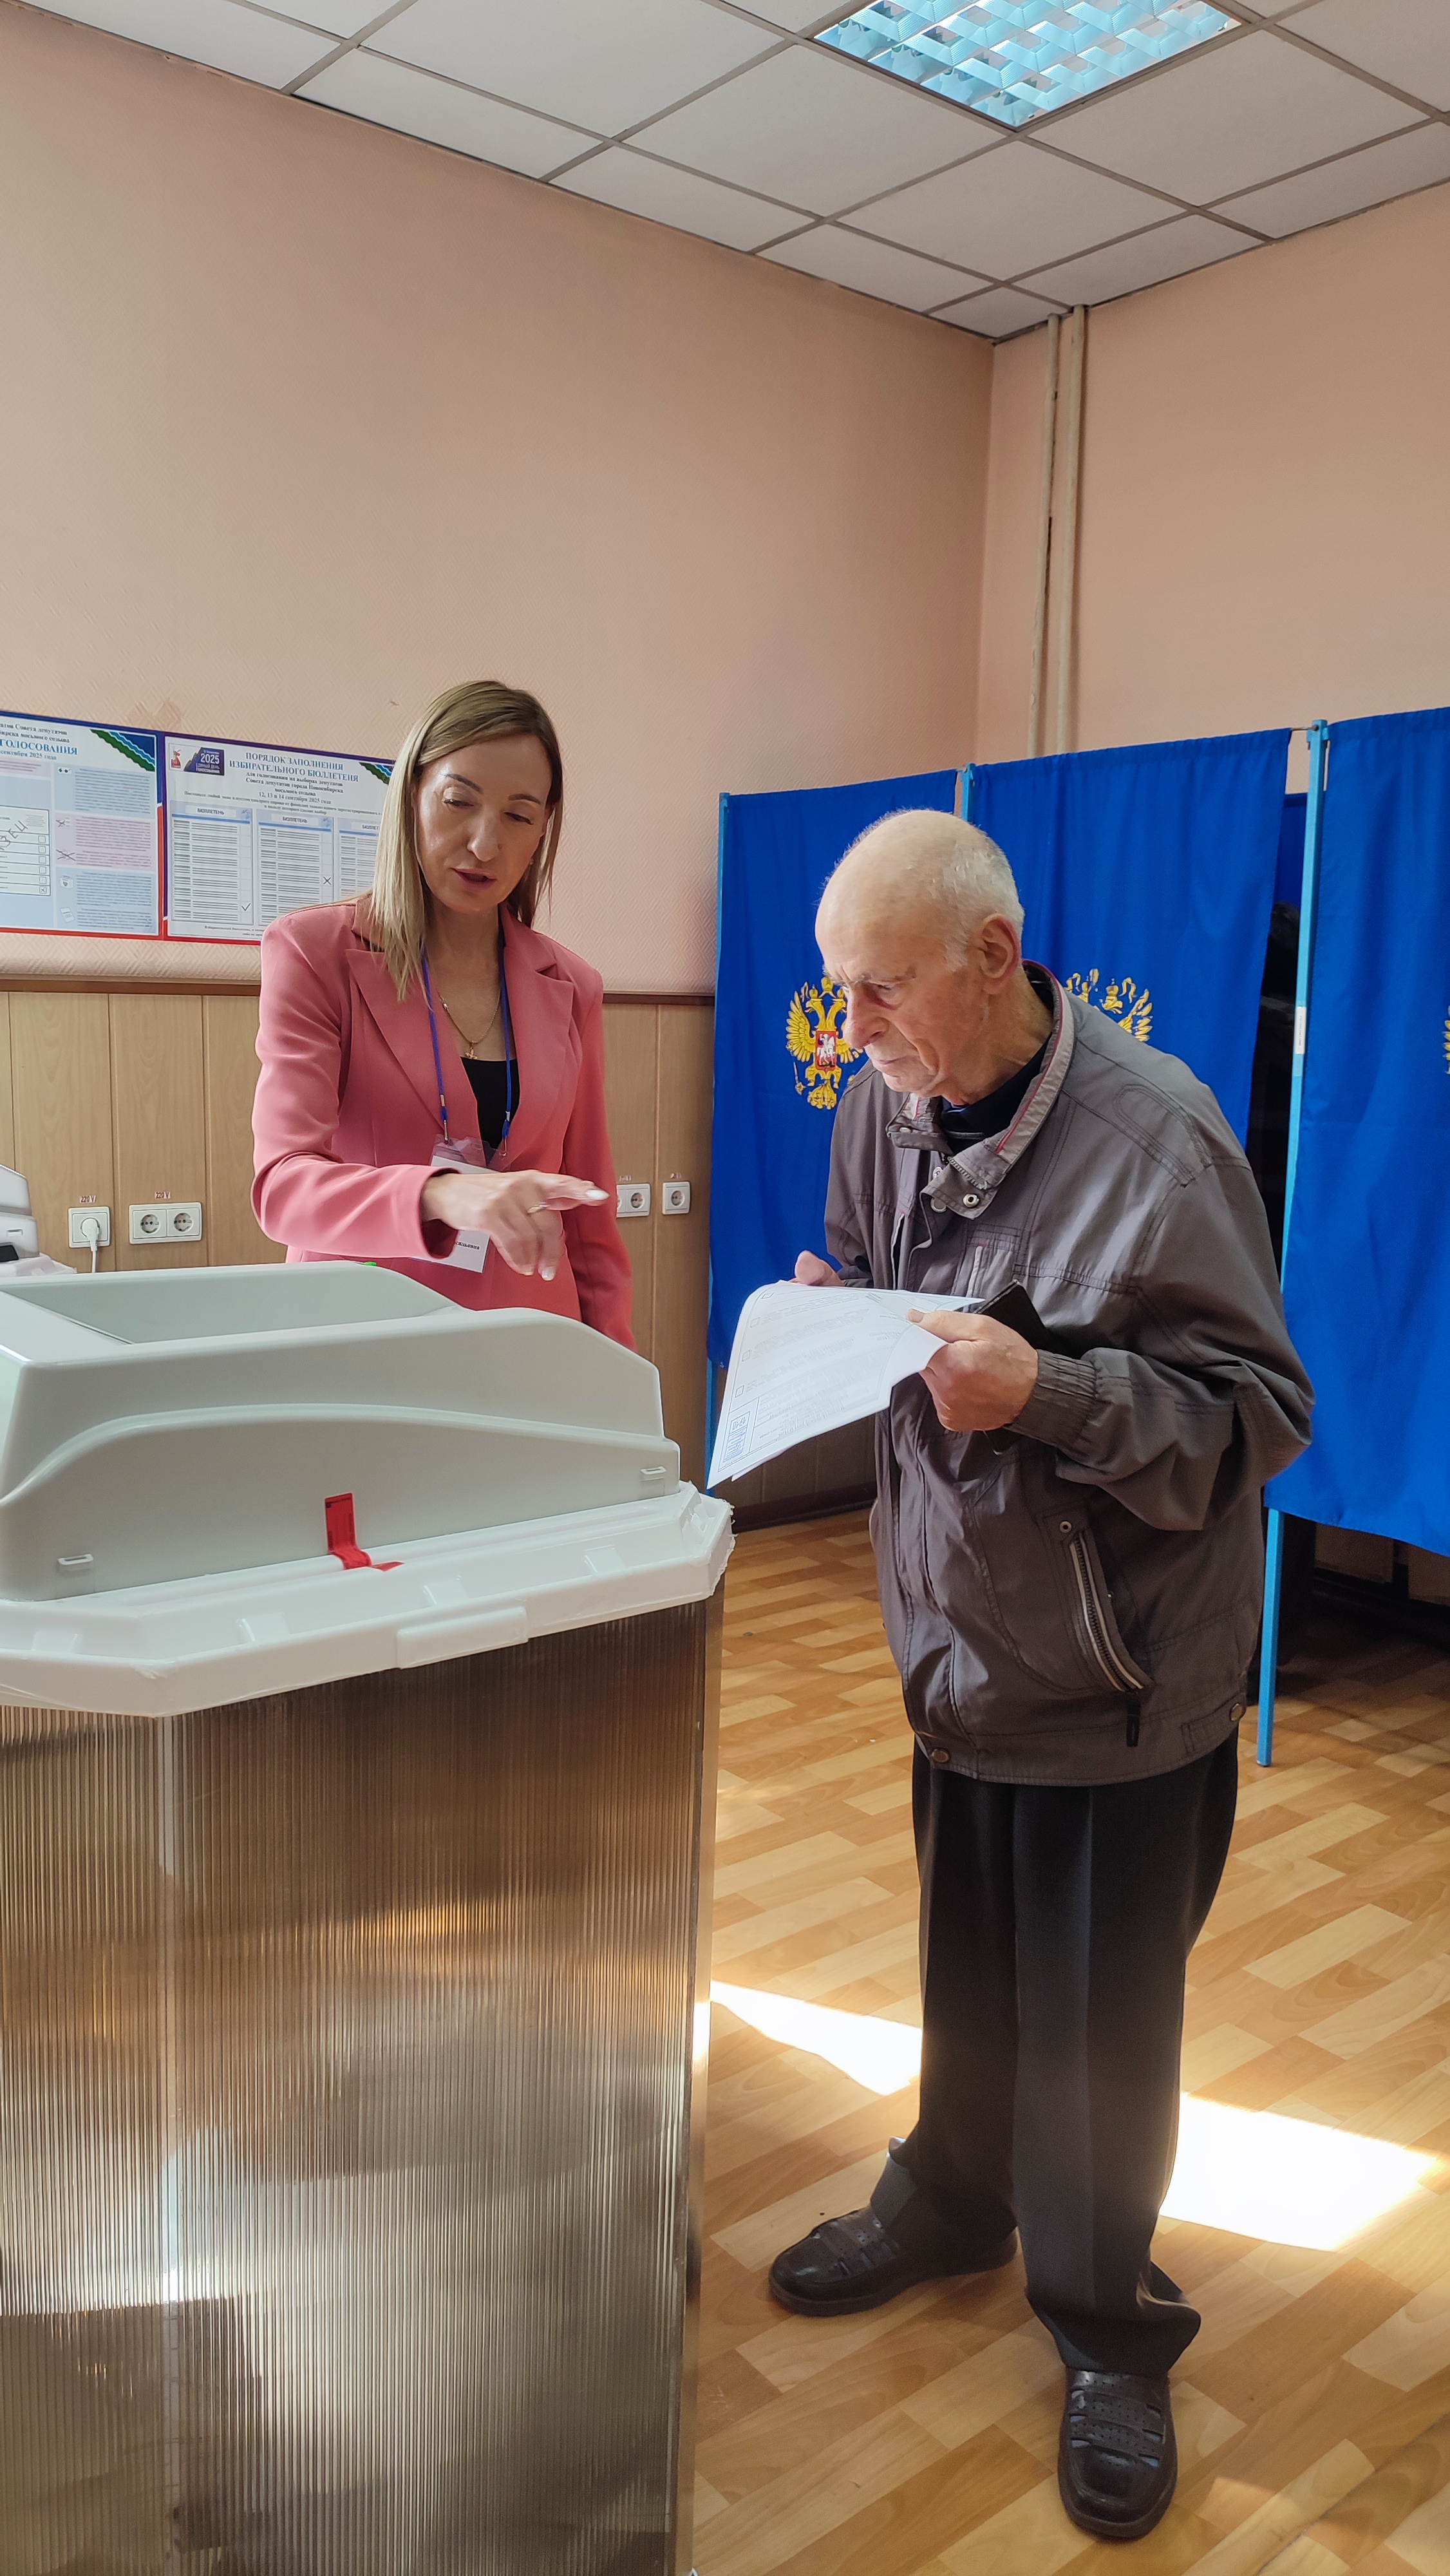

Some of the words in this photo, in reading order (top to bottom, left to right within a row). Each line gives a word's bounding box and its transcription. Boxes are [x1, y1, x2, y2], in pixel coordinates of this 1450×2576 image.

[200, 753, 220, 764] 2025
[246, 752, 285, 764] ПОРЯДОК
[288, 757, 344, 771] ЗАПОЛНЕНИЯ
[229, 760, 306, 775] ИЗБИРАТЕЛЬНОГО
[307, 770, 359, 782] БЮЛЛЕТЕНЯ
